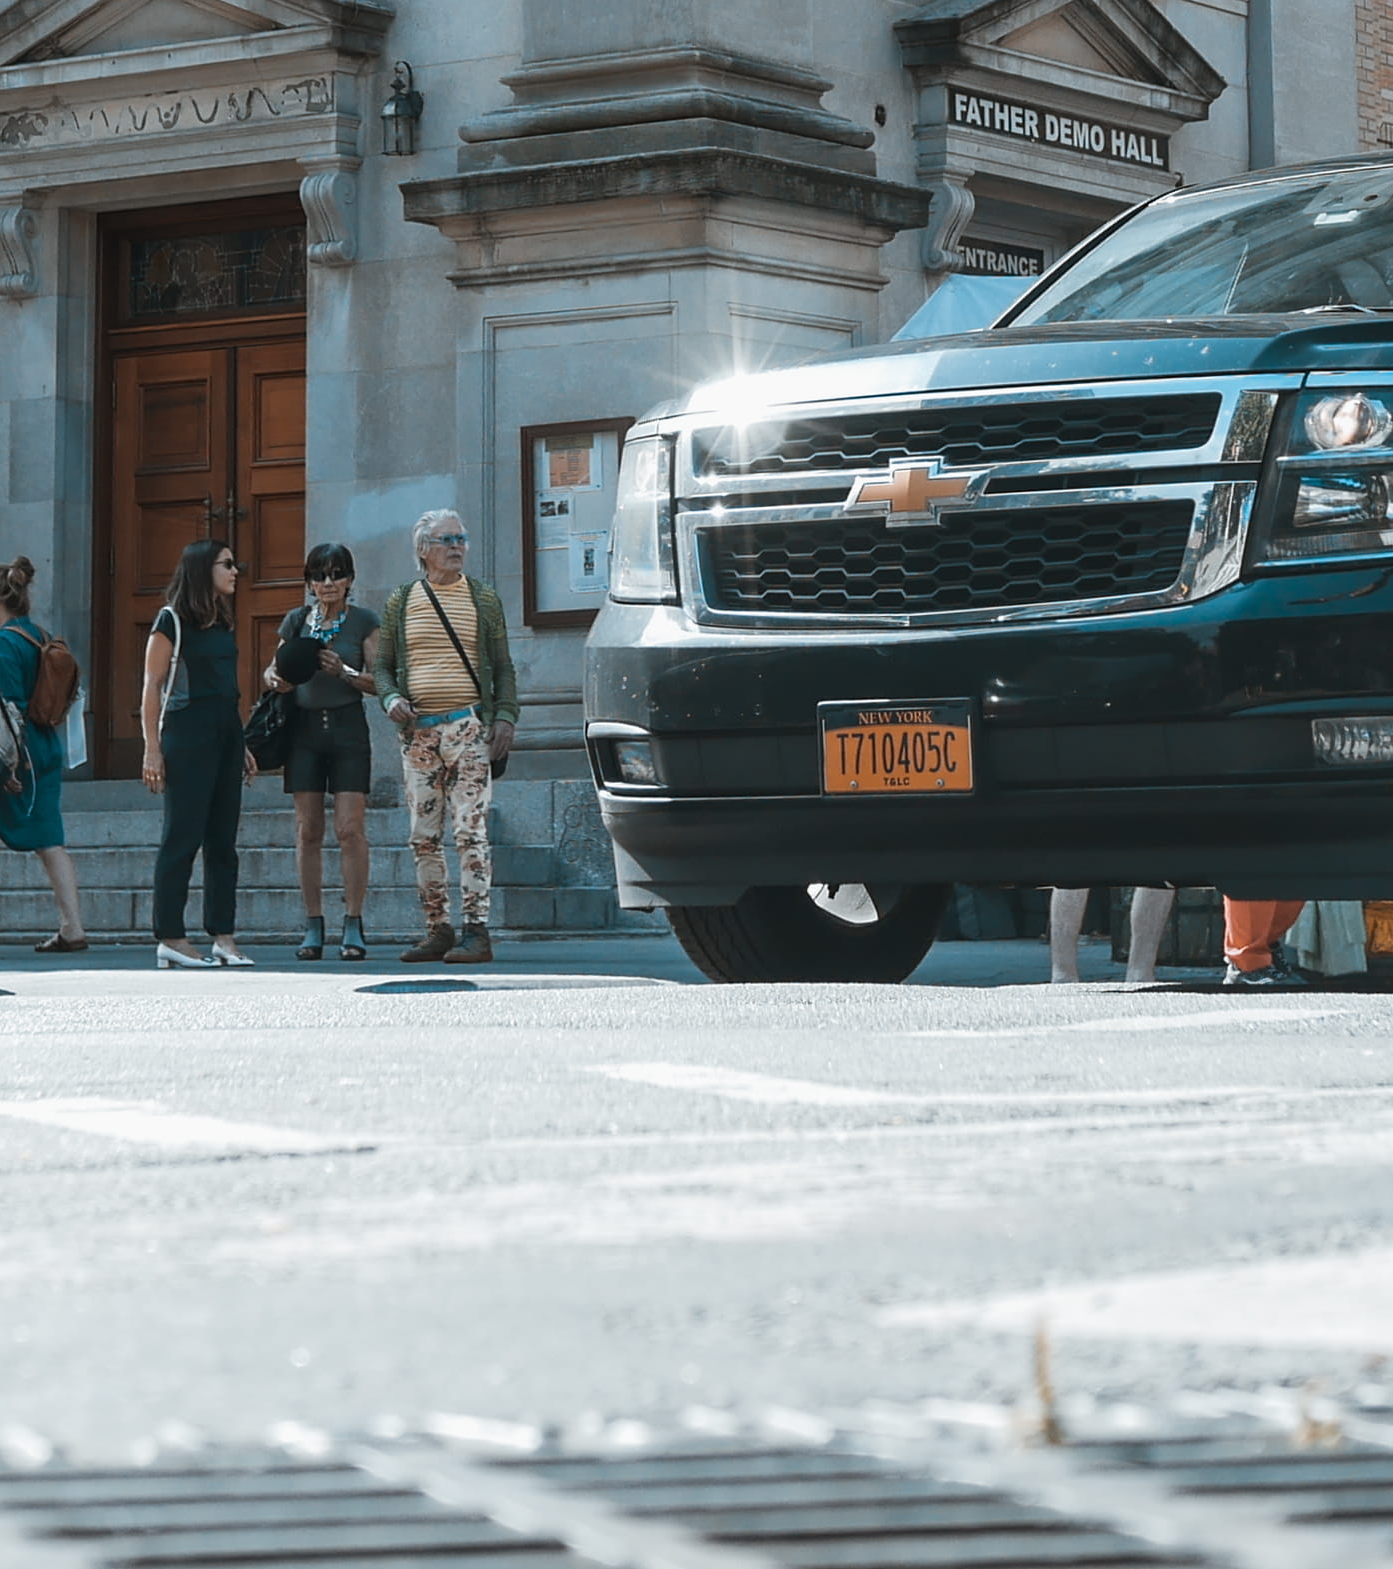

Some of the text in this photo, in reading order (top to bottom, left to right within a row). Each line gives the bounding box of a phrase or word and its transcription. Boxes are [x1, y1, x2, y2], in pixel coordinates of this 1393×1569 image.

[954, 93, 1164, 166] FATHER DEMO HALL
[859, 710, 933, 725] NEW YORK
[836, 731, 957, 775] T710405C
